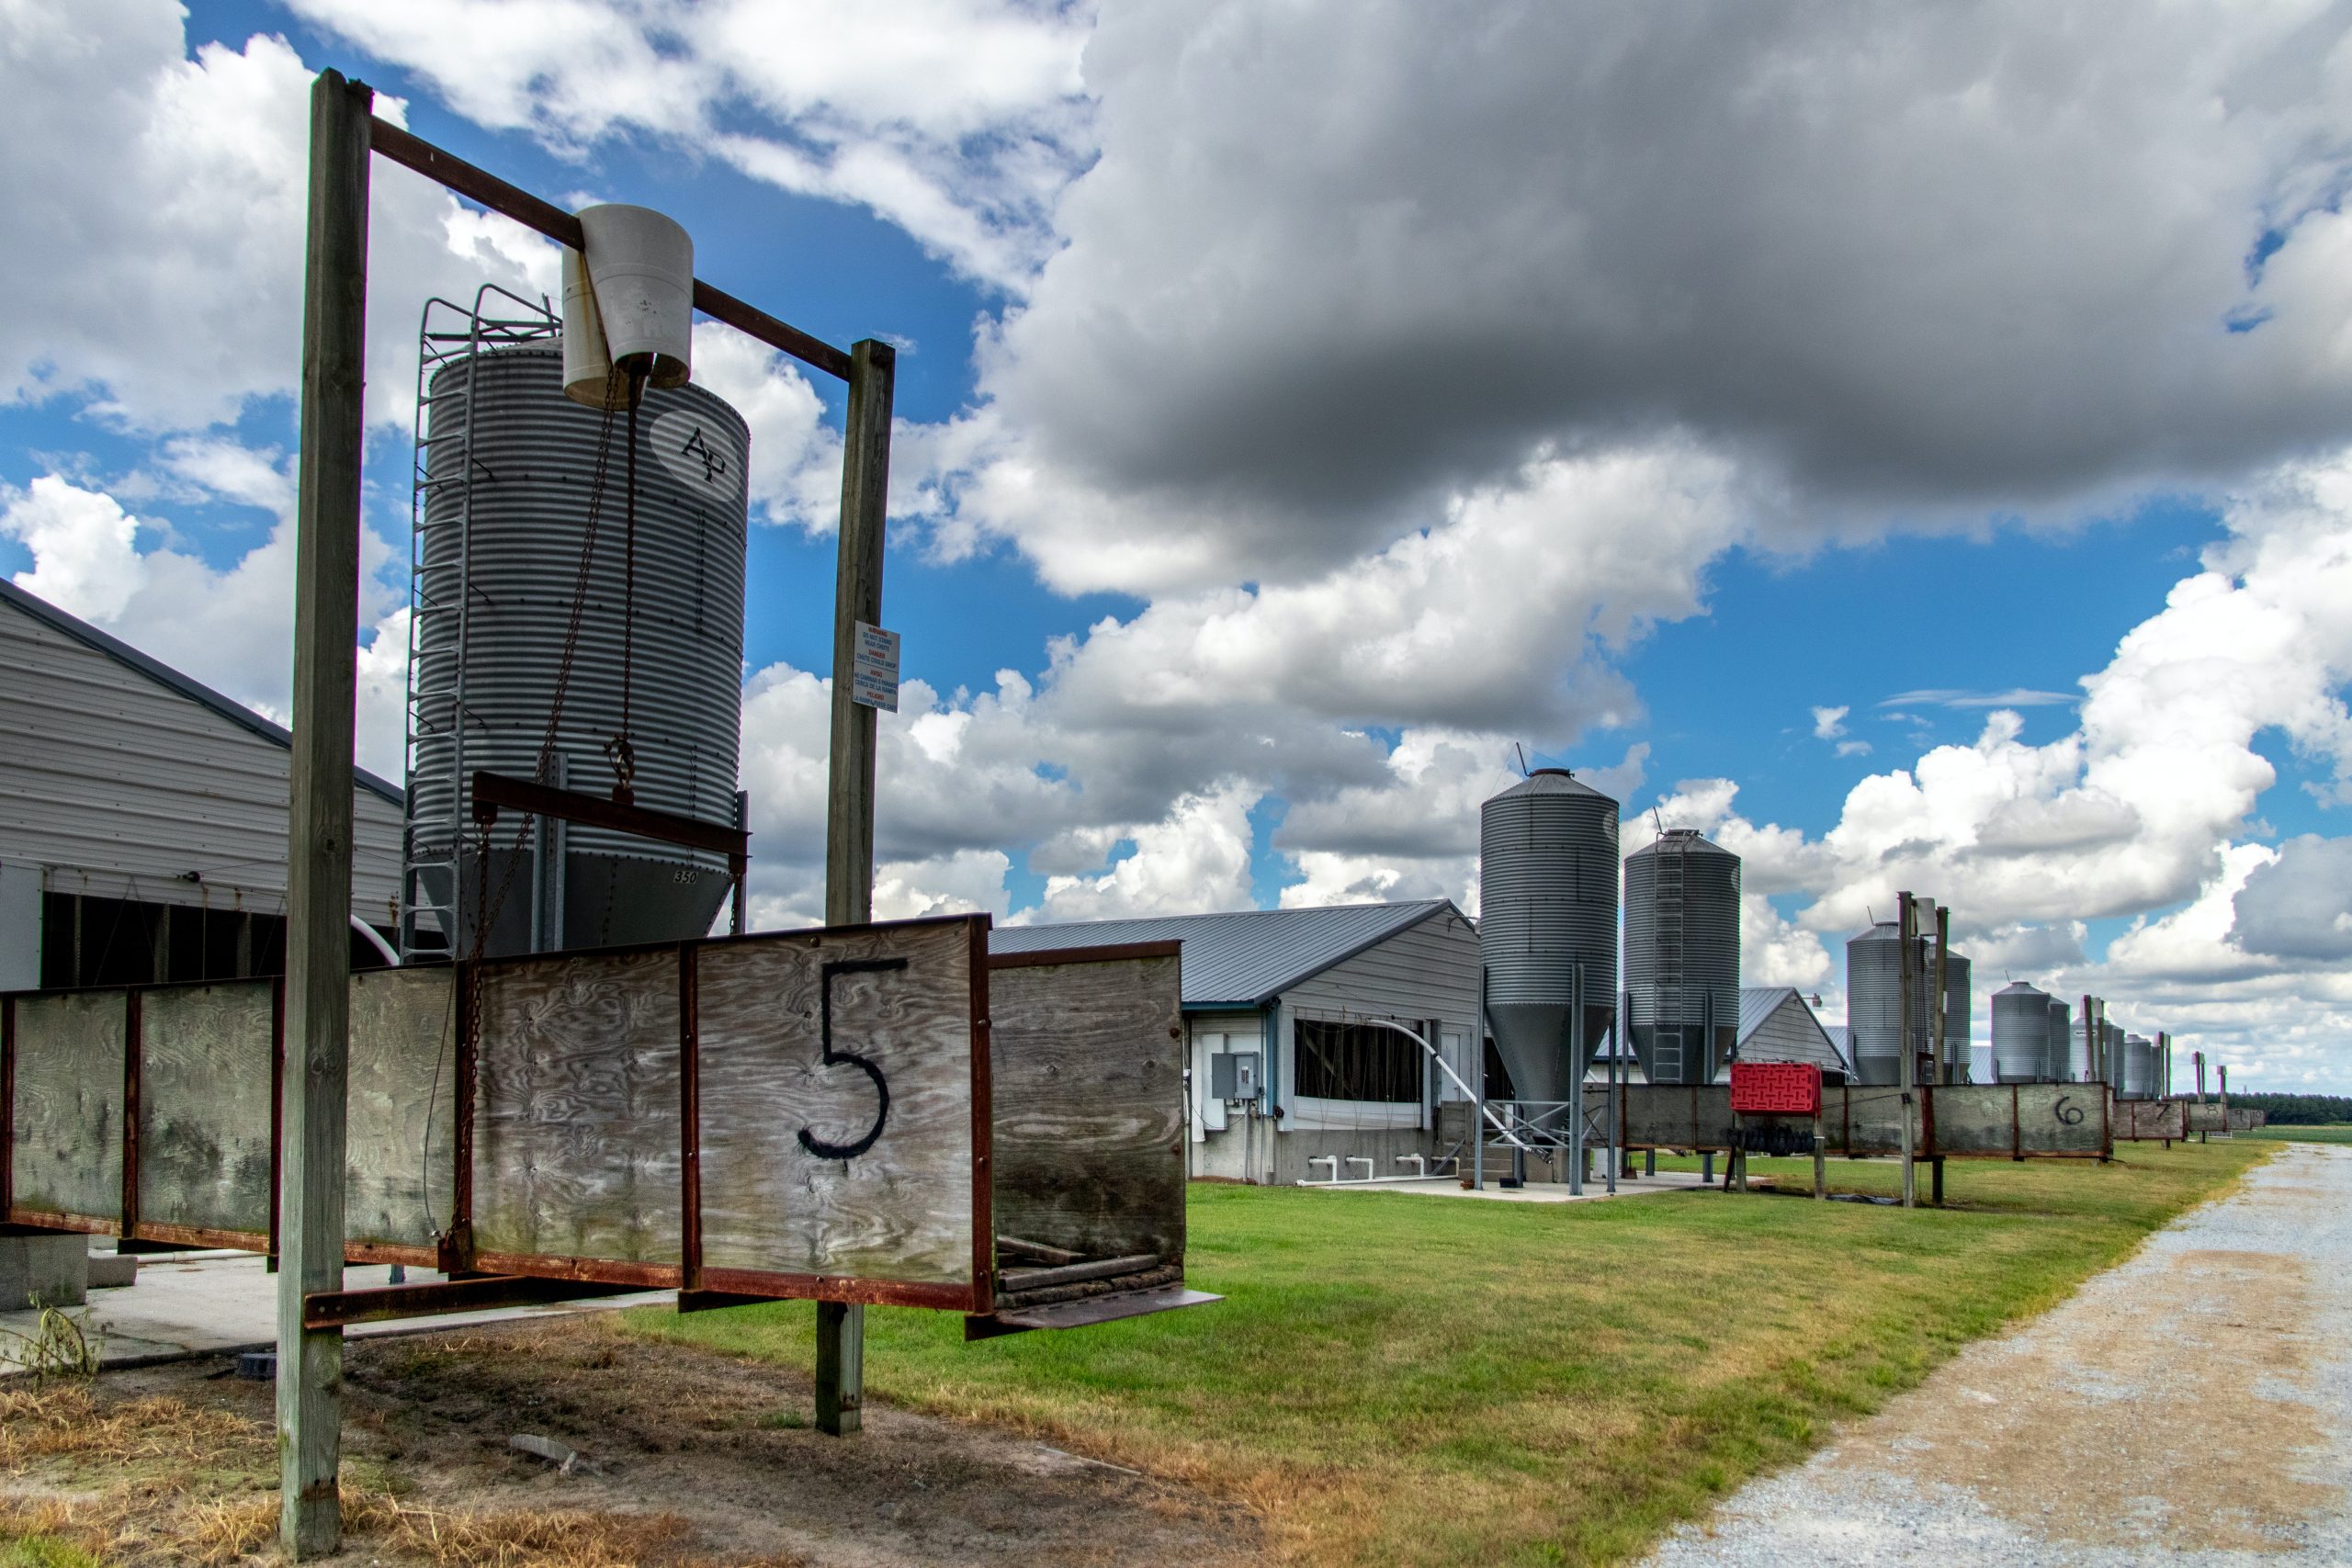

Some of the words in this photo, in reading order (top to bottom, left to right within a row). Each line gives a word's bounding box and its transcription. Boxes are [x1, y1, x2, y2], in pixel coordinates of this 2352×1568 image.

[869, 649, 885, 659] DANGER
[674, 871, 697, 884] 350
[799, 958, 909, 1160] 5
[2054, 1096, 2085, 1125] 6
[2156, 1103, 2170, 1120] 7
[2205, 1104, 2218, 1116] 8
[2234, 1109, 2243, 1122] 9
